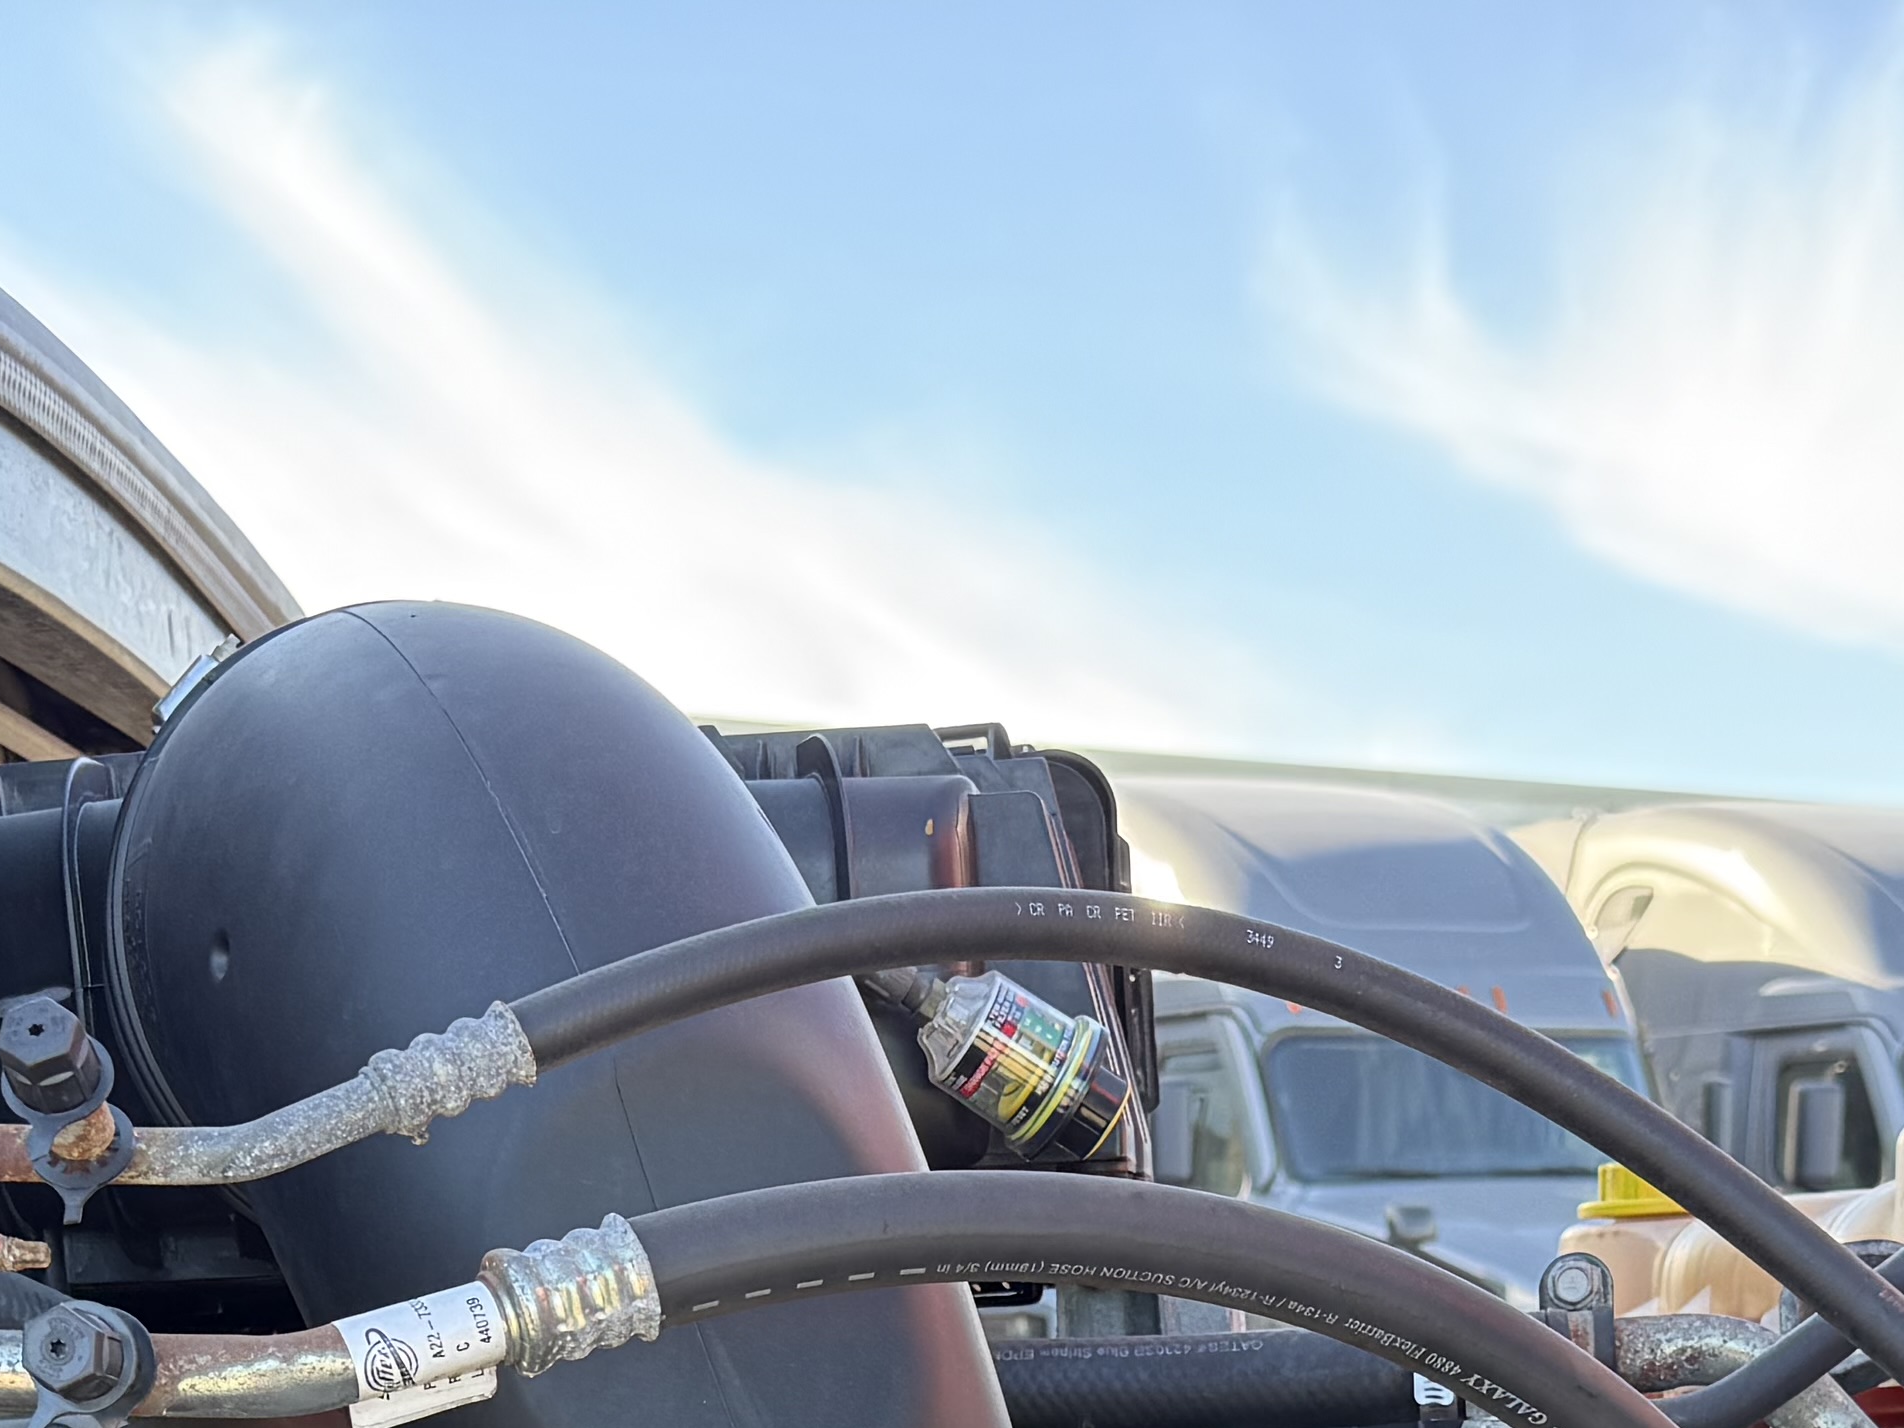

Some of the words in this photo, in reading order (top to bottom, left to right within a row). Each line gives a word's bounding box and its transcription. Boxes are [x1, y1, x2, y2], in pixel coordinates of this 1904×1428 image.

[1058, 903, 1073, 917] PA
[1115, 907, 1135, 922] PET
[1246, 929, 1275, 949] 3449
[1334, 955, 1342, 970] 3
[955, 1262, 980, 1274] 3/4
[985, 1261, 1044, 1274] (19mm)
[1049, 1263, 1097, 1276] HOSE
[1100, 1267, 1175, 1286] SUCTION
[1178, 1277, 1207, 1290] A/C
[1209, 1281, 1276, 1306] R-1234yf
[467, 1297, 492, 1344] 440739
[1287, 1300, 1339, 1324] R-134a
[1097, 1345, 1129, 1358] Blue
[1344, 1319, 1425, 1360] FlexBarrier
[1425, 1352, 1461, 1376] 4880
[1460, 1373, 1548, 1426] GALAXY
